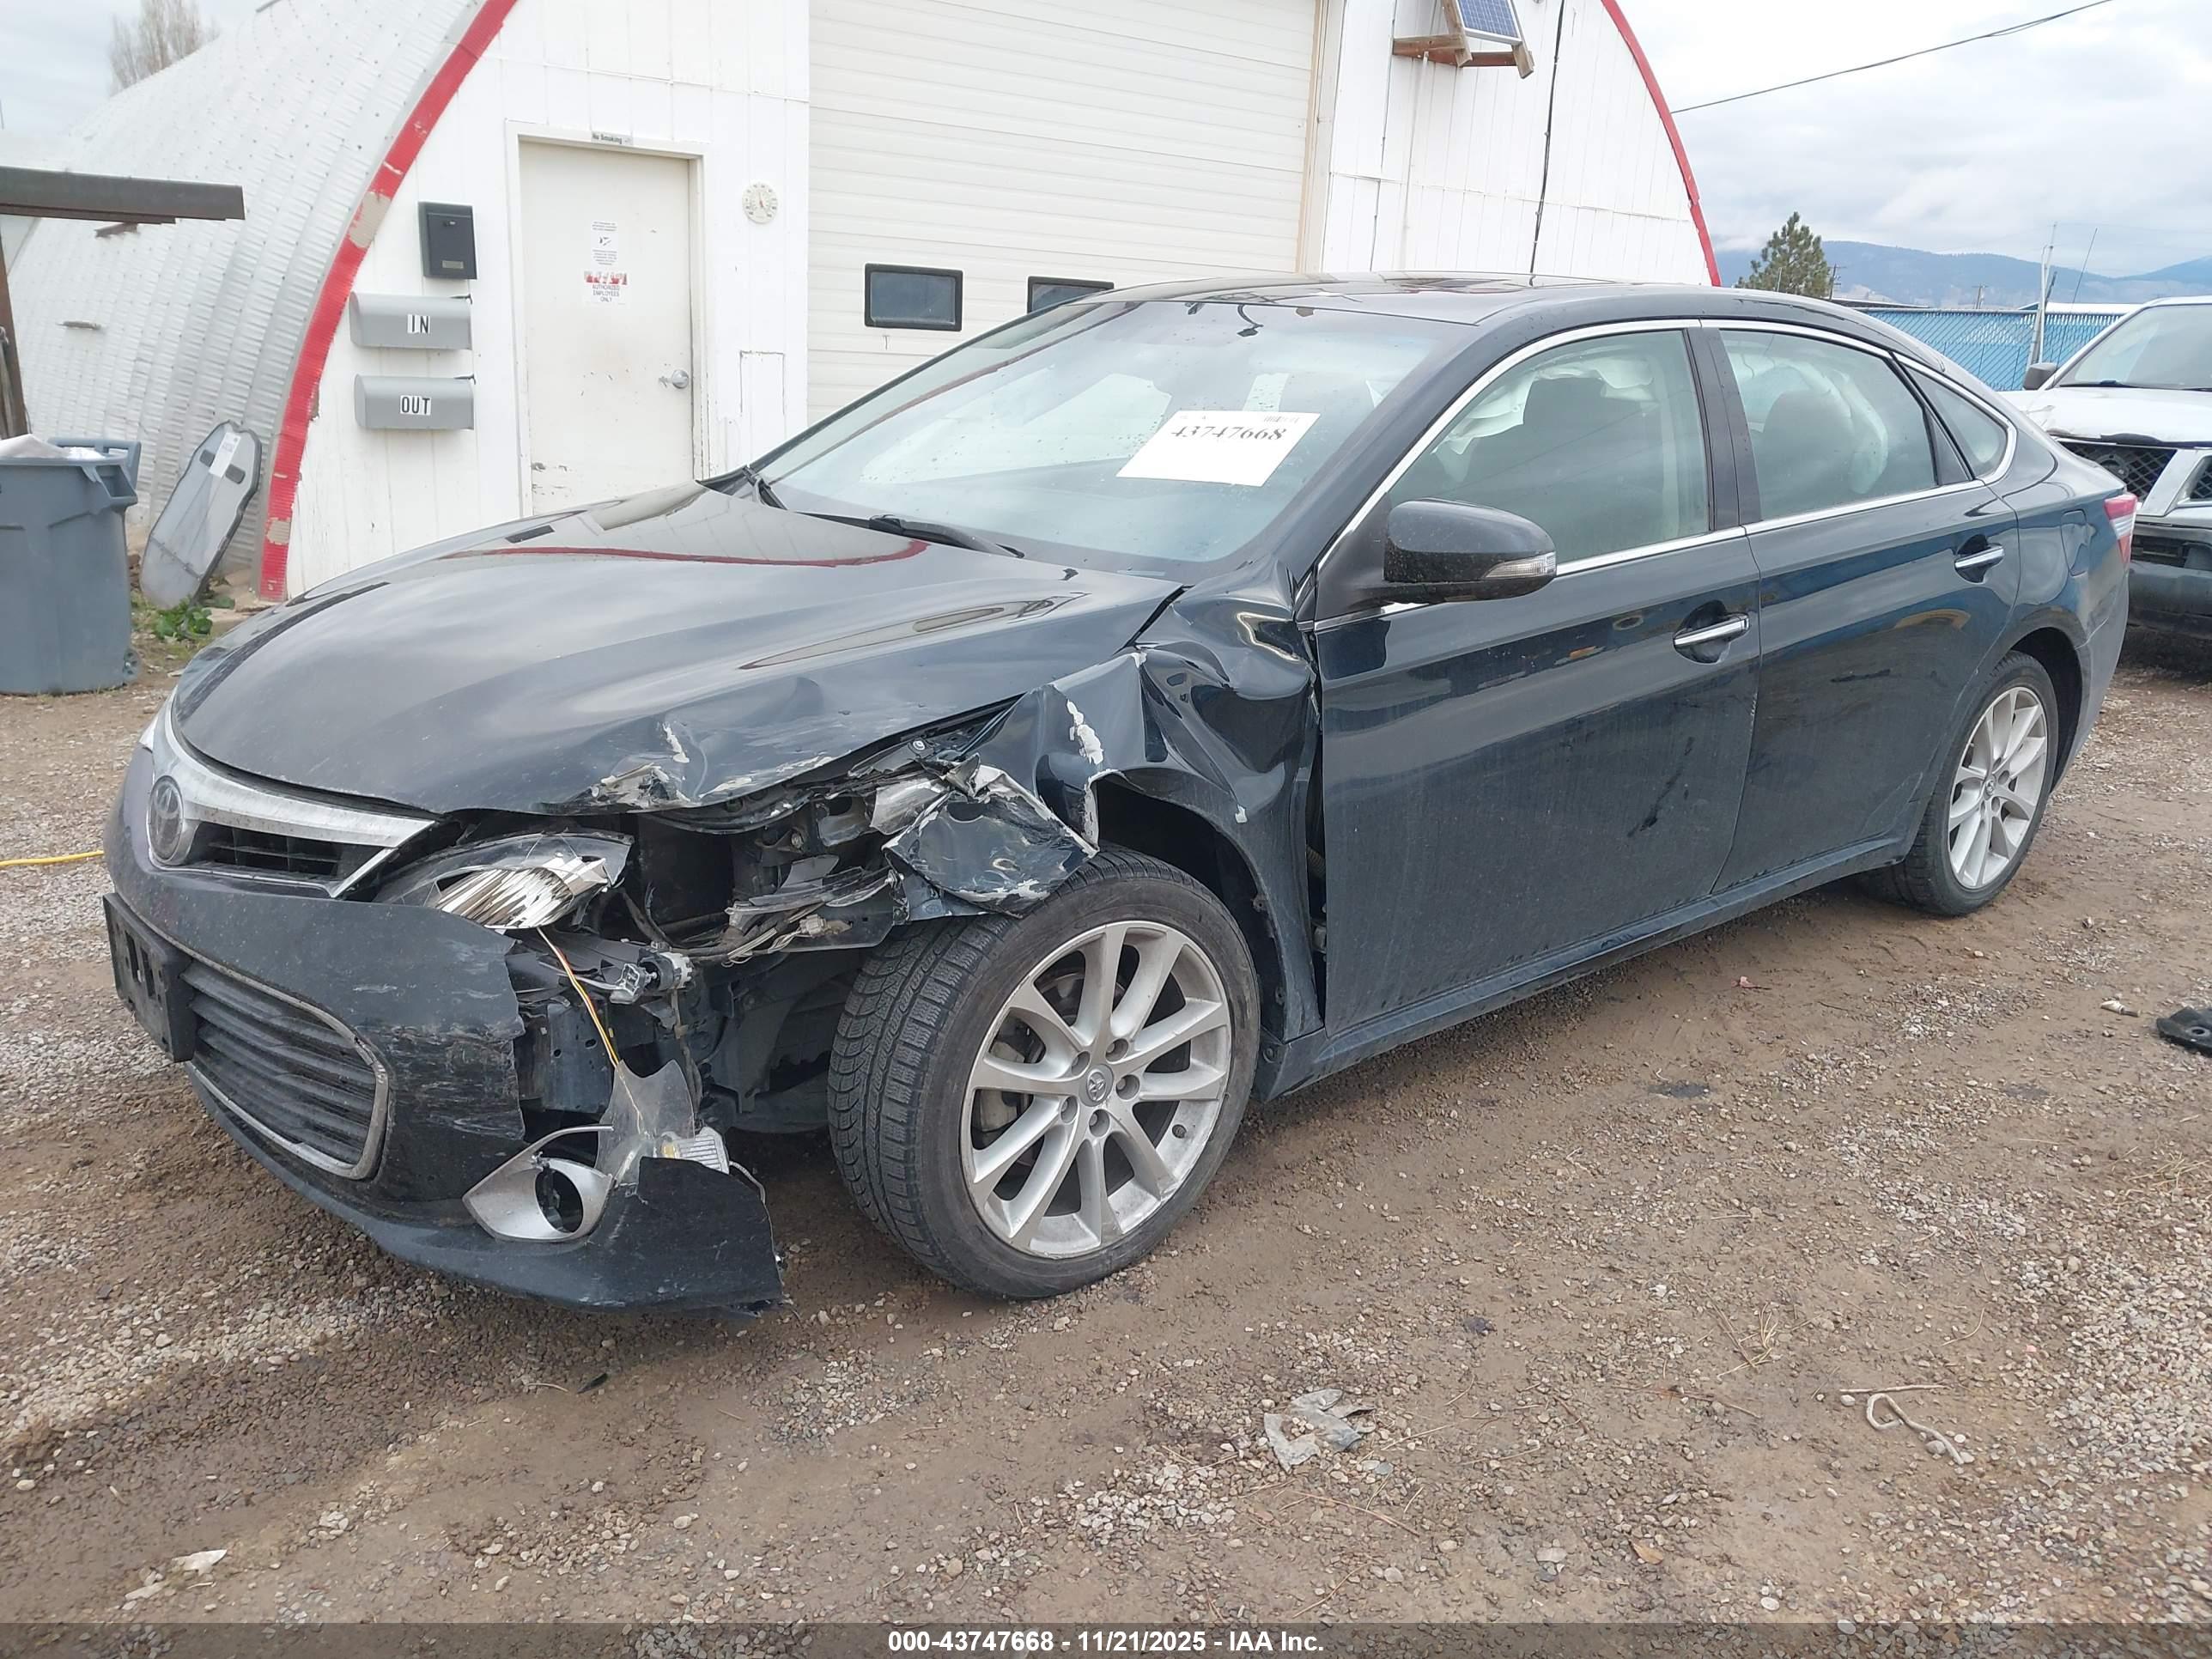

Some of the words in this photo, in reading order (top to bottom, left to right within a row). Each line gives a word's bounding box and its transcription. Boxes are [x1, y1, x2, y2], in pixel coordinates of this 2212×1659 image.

[412, 315, 429, 333] IN
[401, 397, 430, 415] OUT
[1170, 425, 1288, 441] 43747668
